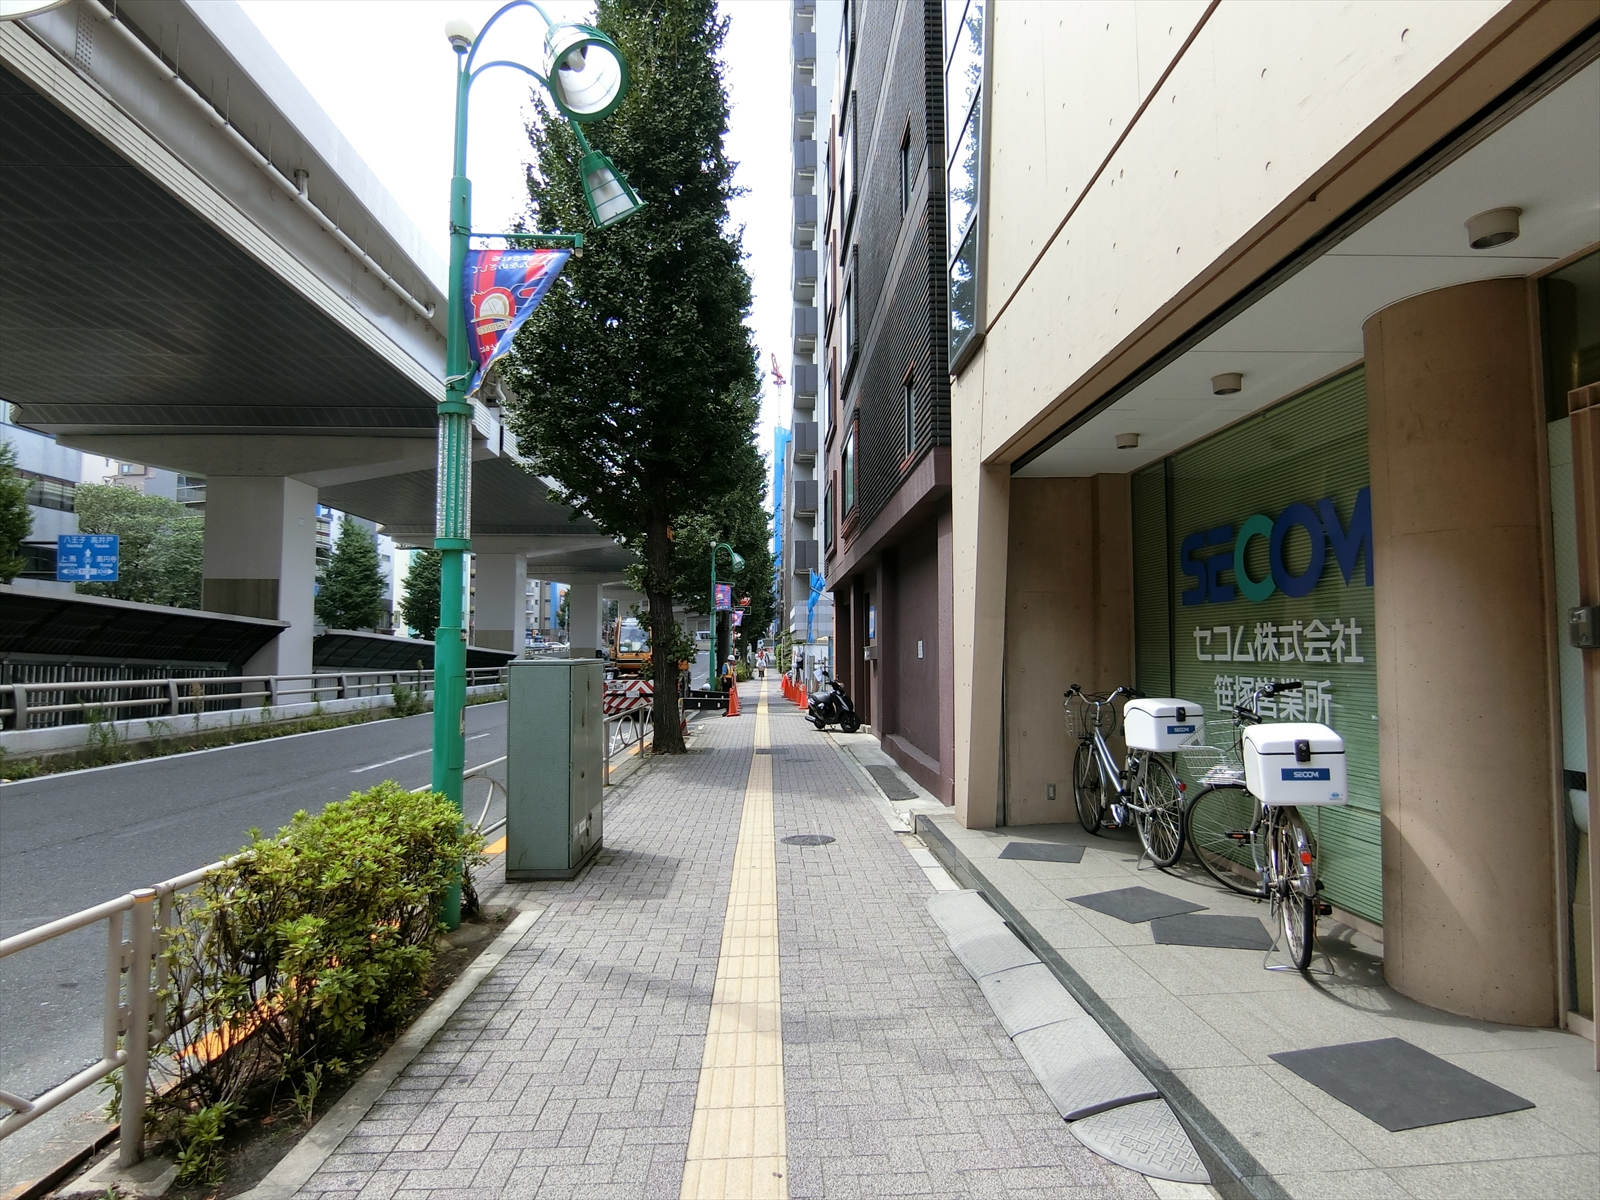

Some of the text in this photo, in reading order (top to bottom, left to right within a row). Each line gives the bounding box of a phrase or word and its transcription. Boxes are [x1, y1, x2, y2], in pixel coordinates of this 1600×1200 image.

[96, 555, 117, 563] 高円寺
[1182, 487, 1373, 606] SECOM
[1193, 618, 1364, 663] セコム株式会社
[1214, 675, 1332, 725] 笹塚営業所
